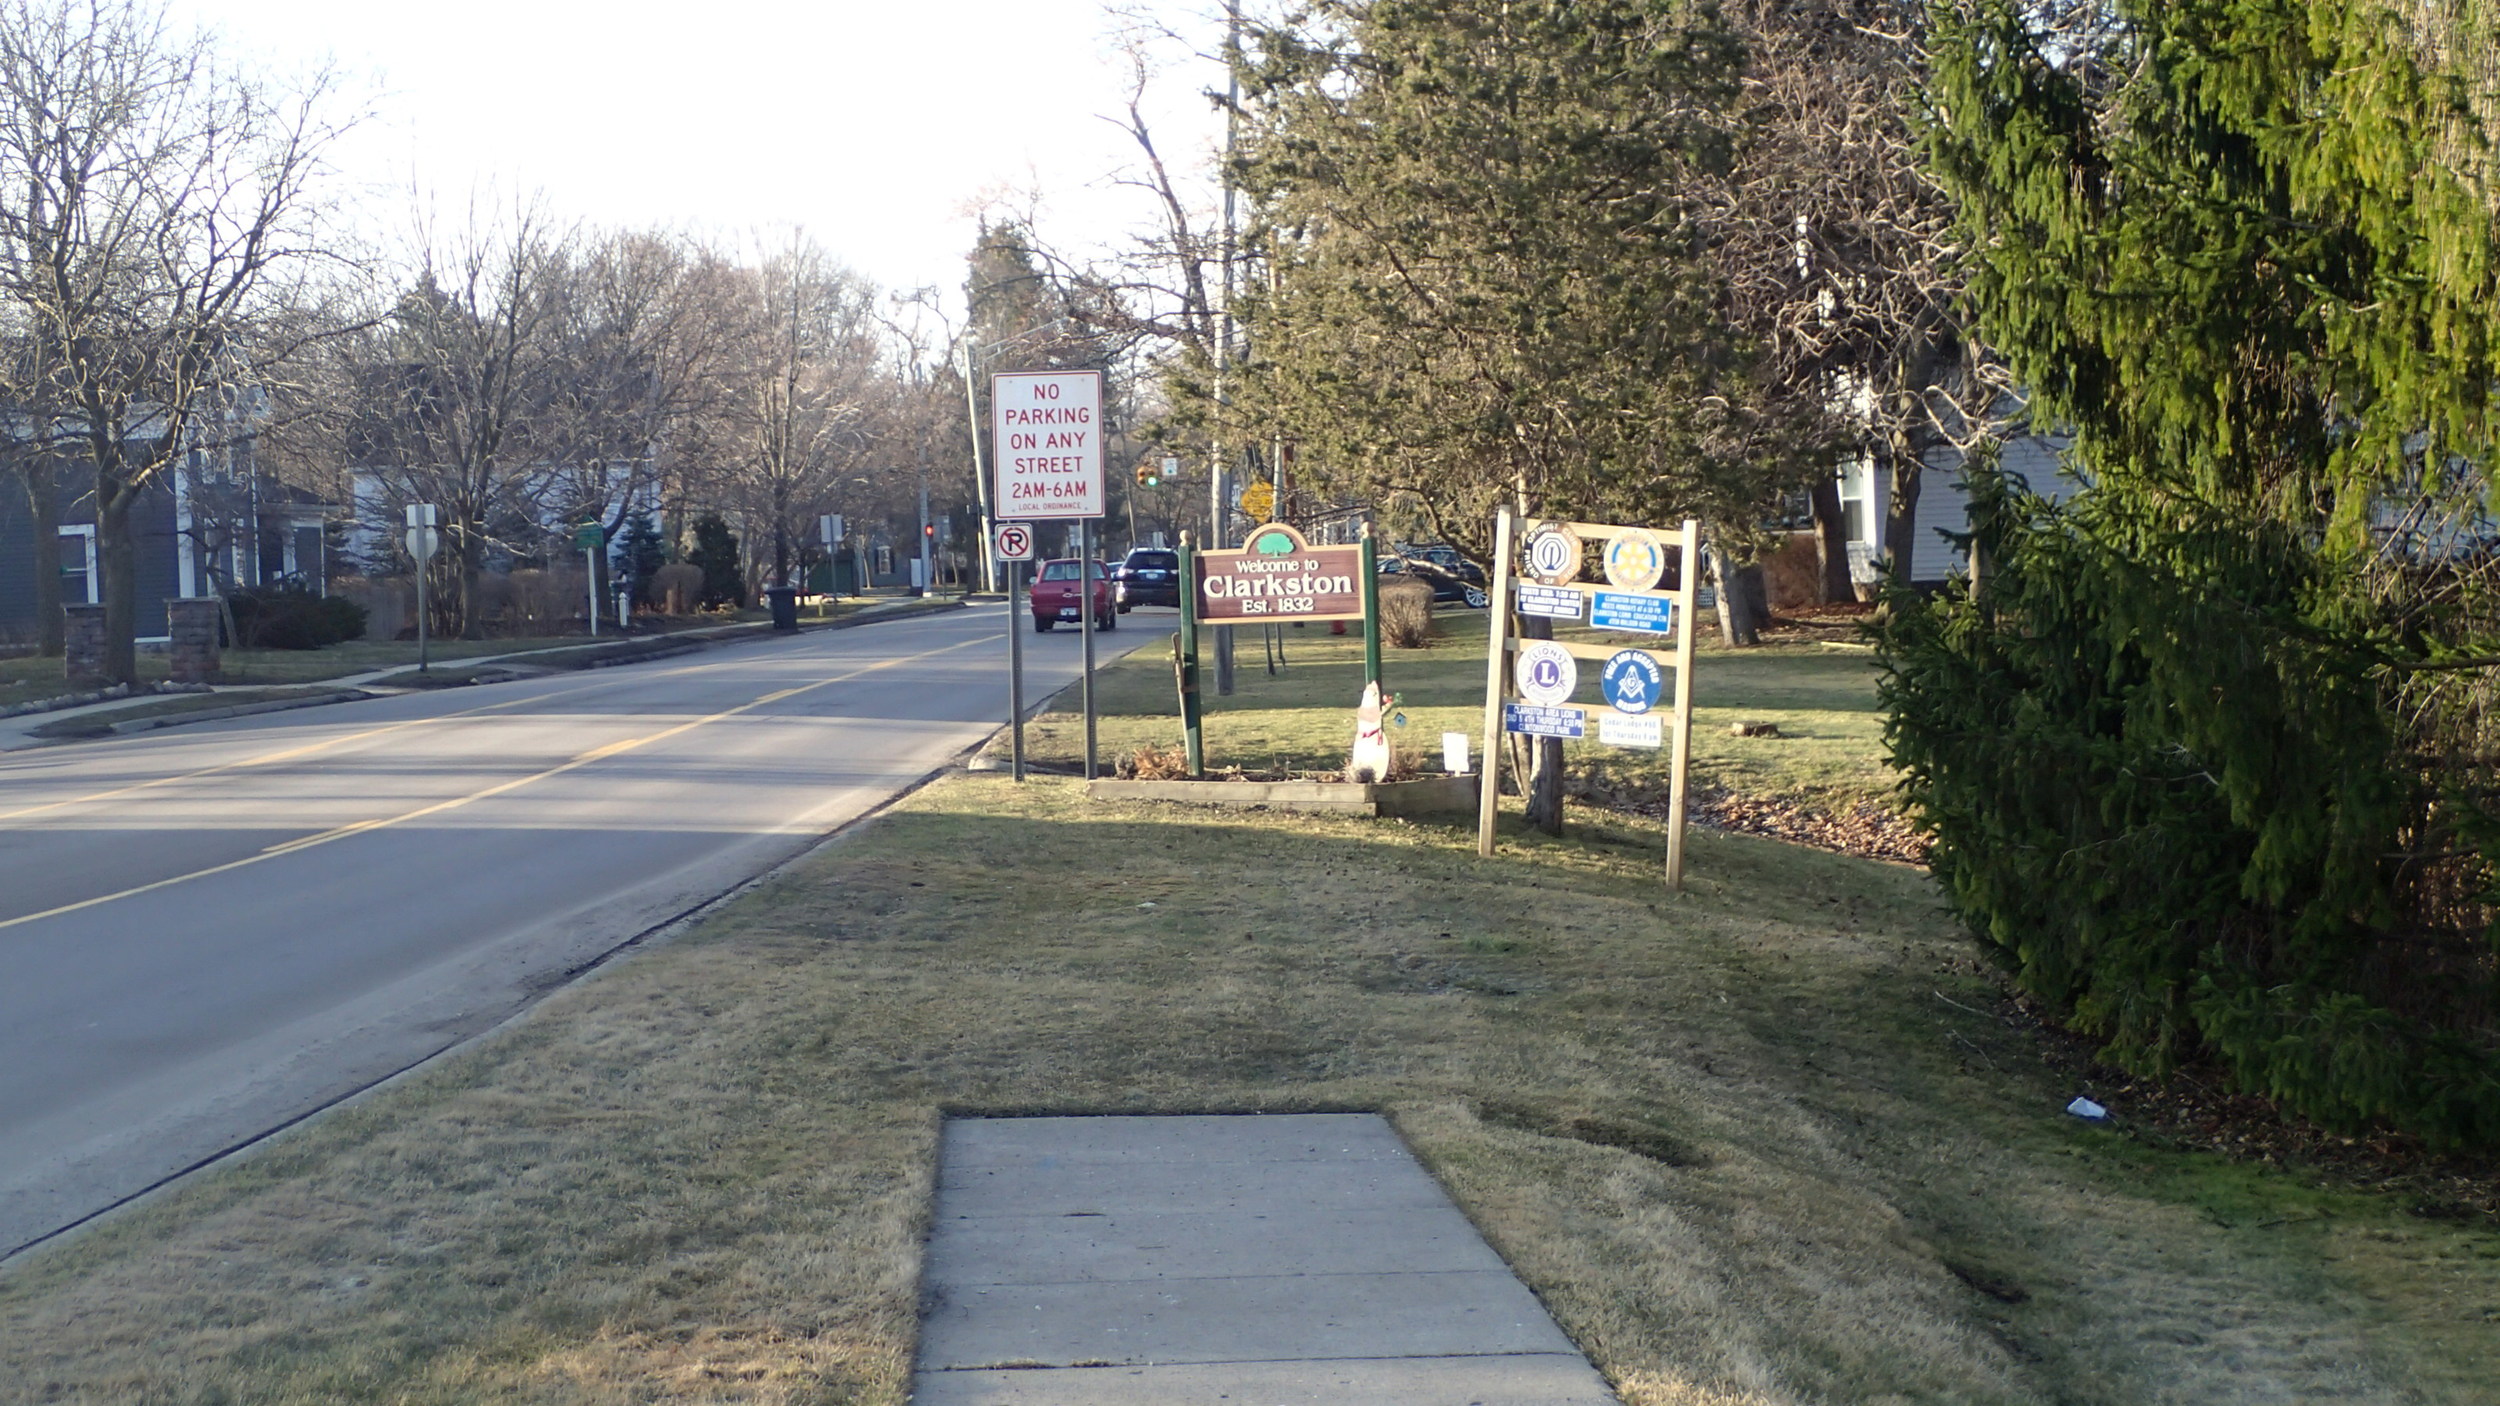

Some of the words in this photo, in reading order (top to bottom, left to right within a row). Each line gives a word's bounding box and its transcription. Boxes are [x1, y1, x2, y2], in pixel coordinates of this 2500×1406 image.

[1034, 384, 1059, 400] NO
[1006, 407, 1089, 425] PARKING
[1011, 433, 1036, 450] ON
[1046, 432, 1086, 448] ANY
[1015, 456, 1083, 474] STREET
[1012, 481, 1086, 498] 2AM-6AM
[1043, 502, 1081, 510] ORDINANCE
[1236, 559, 1298, 573] Welcome
[1304, 559, 1319, 570] to
[1203, 572, 1352, 598] Clarkston
[1242, 599, 1272, 613] Est.
[1278, 597, 1314, 611] 1832
[1533, 648, 1562, 660] LIONS
[1540, 663, 1555, 684] L
[1514, 706, 1544, 716] CLARKSTON
[1546, 709, 1559, 717] AREA
[1561, 710, 1576, 719] LIONS
[1556, 726, 1570, 735] PARK
